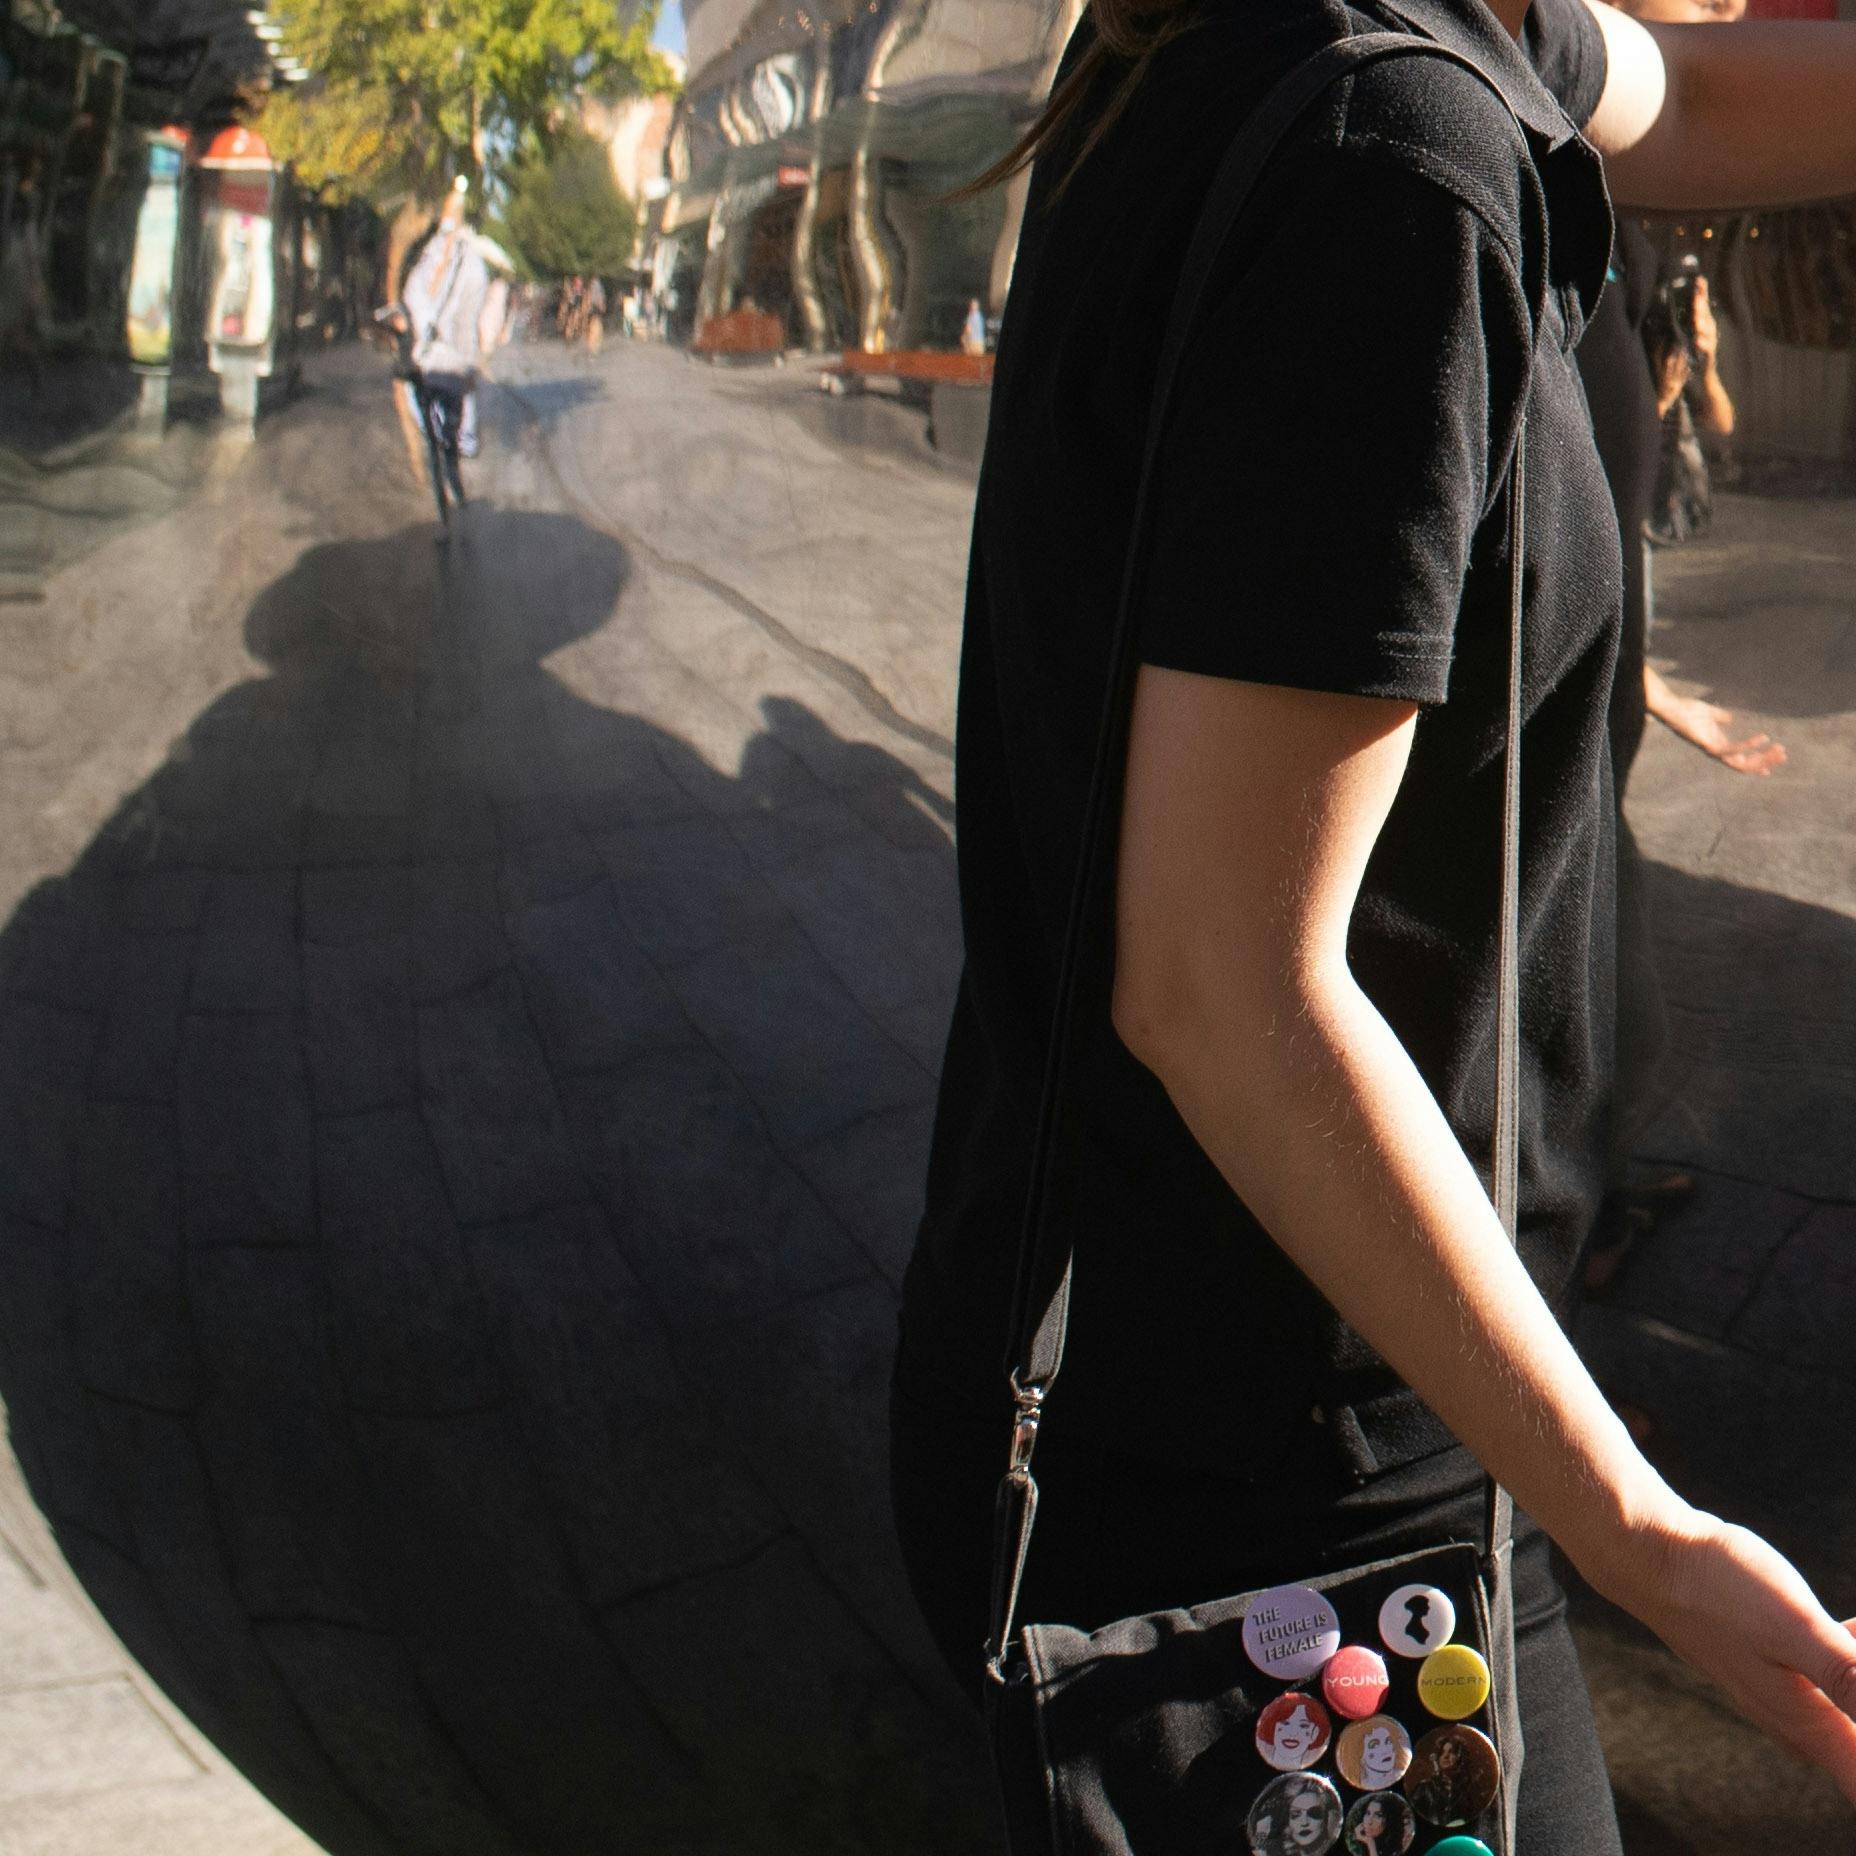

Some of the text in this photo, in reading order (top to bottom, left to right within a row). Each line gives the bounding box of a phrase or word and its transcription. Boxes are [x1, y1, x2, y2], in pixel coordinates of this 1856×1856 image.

[1252, 1607, 1281, 1626] THE
[1259, 1611, 1328, 1645] FUTURE IS
[1265, 1632, 1324, 1663] FEMALE
[1327, 1674, 1389, 1688] YOUNG
[1421, 1675, 1487, 1687] MODERN
